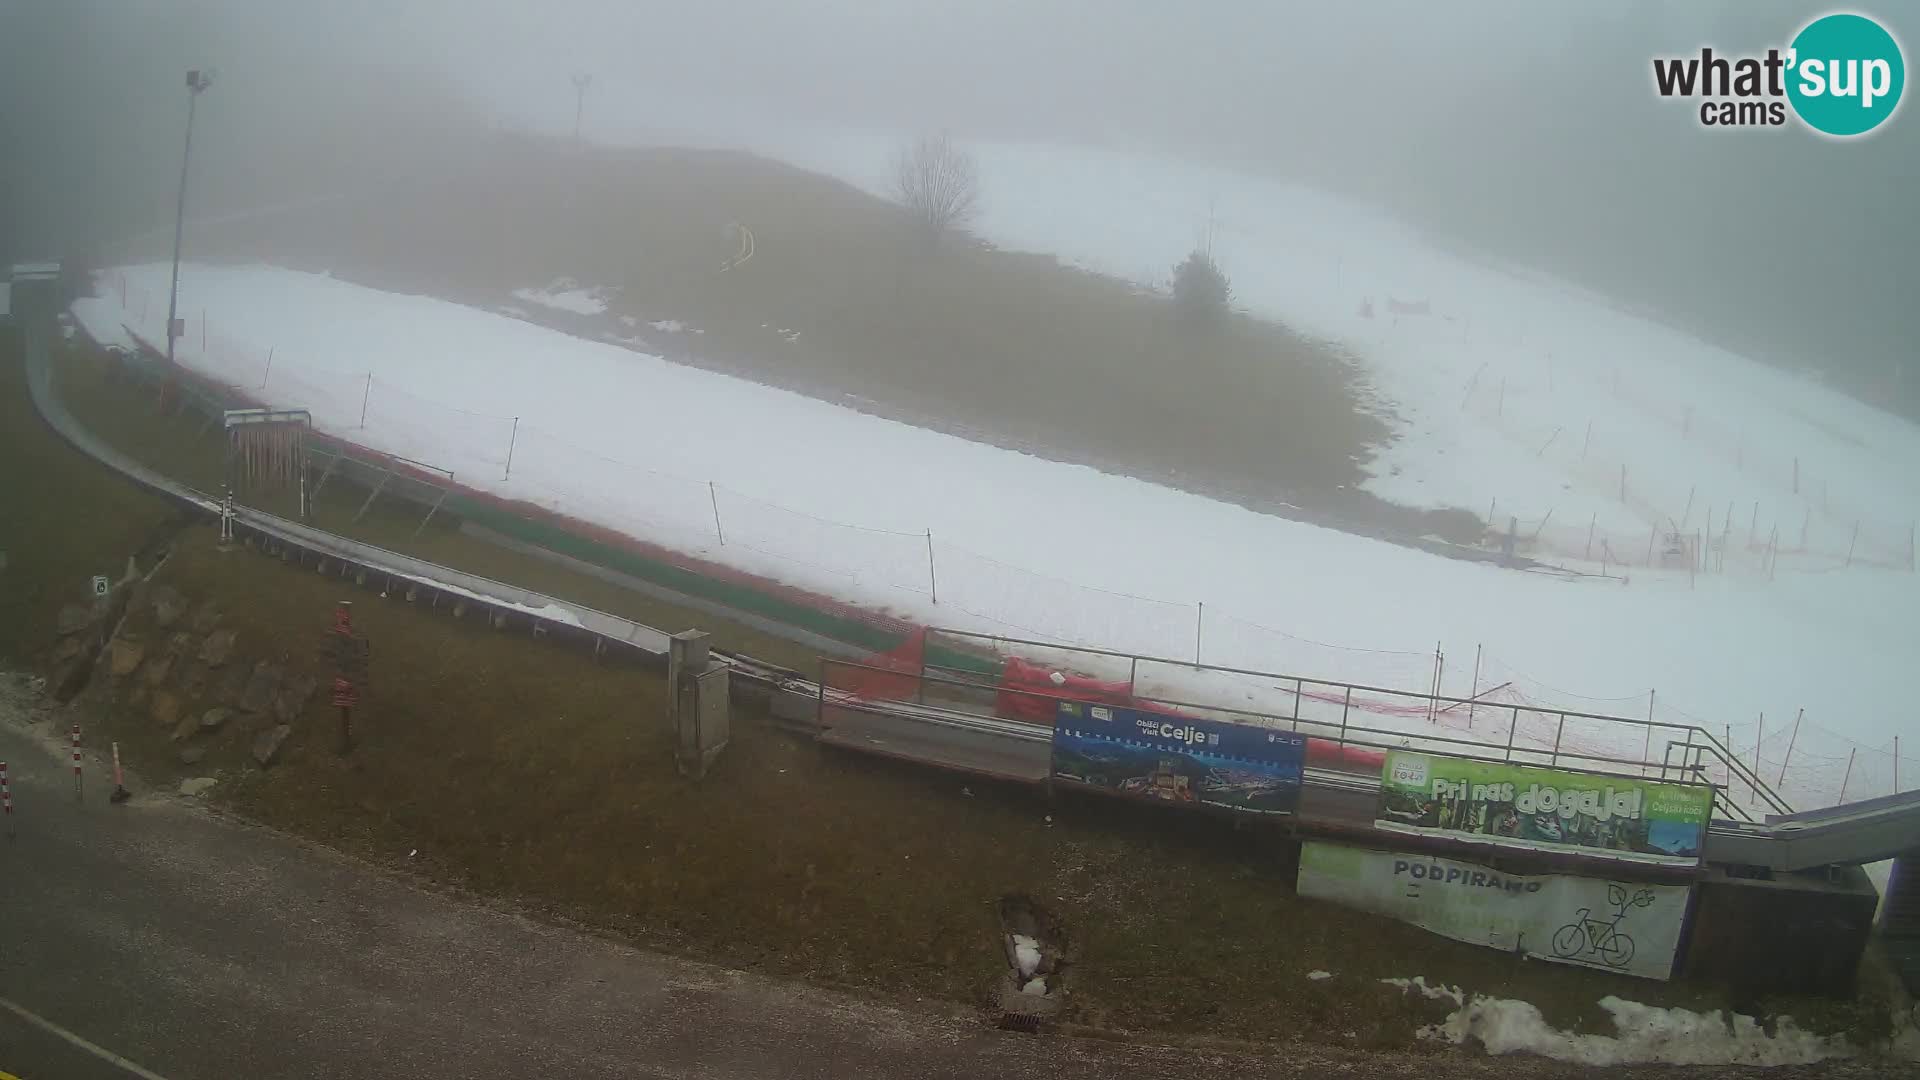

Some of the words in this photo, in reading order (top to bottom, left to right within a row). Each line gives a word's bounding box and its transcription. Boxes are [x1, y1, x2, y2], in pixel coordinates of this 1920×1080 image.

[1142, 727, 1159, 736] Visit
[1160, 723, 1206, 745] Celje
[1431, 778, 1469, 802] Pri
[1471, 782, 1515, 803] nas
[1514, 782, 1643, 822] dogaja!
